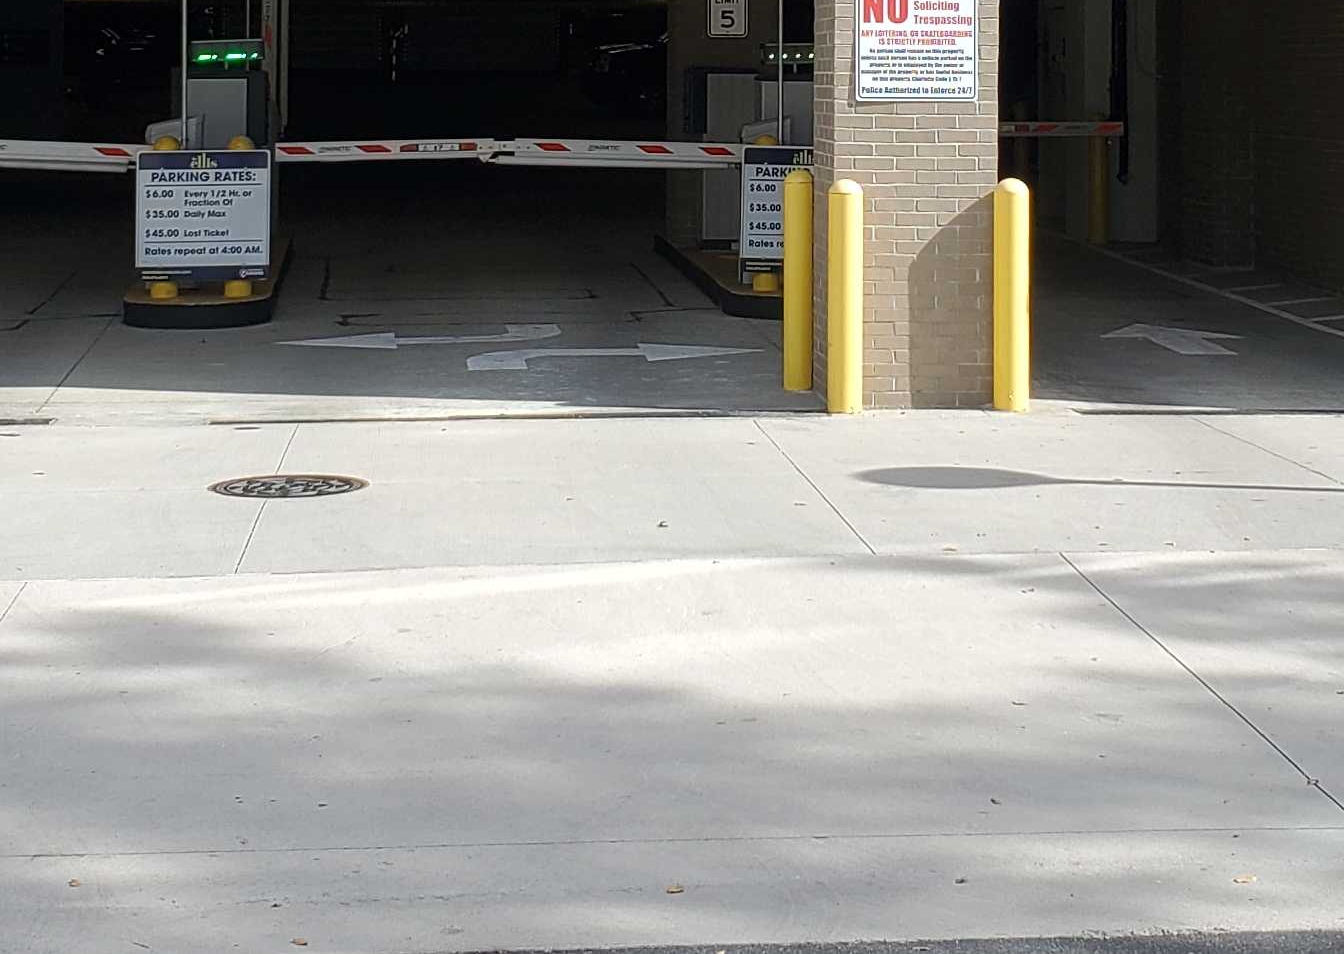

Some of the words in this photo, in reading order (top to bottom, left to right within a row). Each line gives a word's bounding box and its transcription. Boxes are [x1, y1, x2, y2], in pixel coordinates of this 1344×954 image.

[913, 1, 959, 12] Soliciting
[720, 10, 735, 28] 5
[913, 15, 972, 26] Trespassing
[151, 172, 210, 183] PARKING
[214, 171, 256, 182] RATES:
[756, 167, 810, 177] PARK
[184, 190, 208, 199] Every
[211, 190, 226, 198] 1/2
[184, 210, 205, 218] Daily
[203, 229, 229, 237] Ticket
[748, 239, 774, 248] Rates
[145, 247, 172, 255] Rates
[174, 247, 206, 256] repeat
[209, 246, 219, 254] at
[221, 246, 242, 254] 4:00
